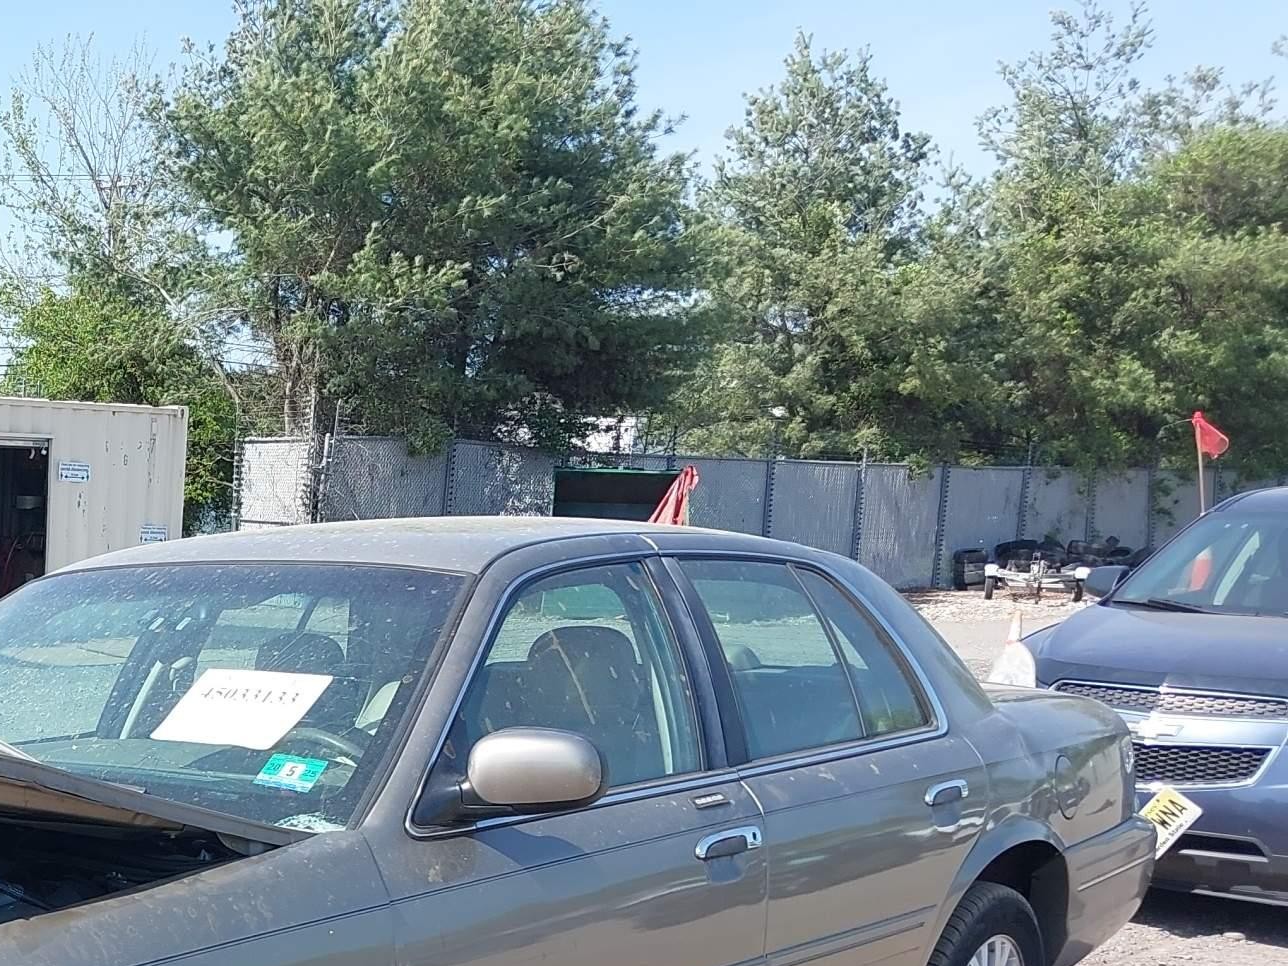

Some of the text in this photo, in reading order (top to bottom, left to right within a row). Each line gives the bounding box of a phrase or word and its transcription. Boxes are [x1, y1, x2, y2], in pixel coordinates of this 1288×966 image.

[201, 687, 300, 704] 45033133
[286, 765, 299, 777] 5
[1151, 799, 1188, 830] WNA
